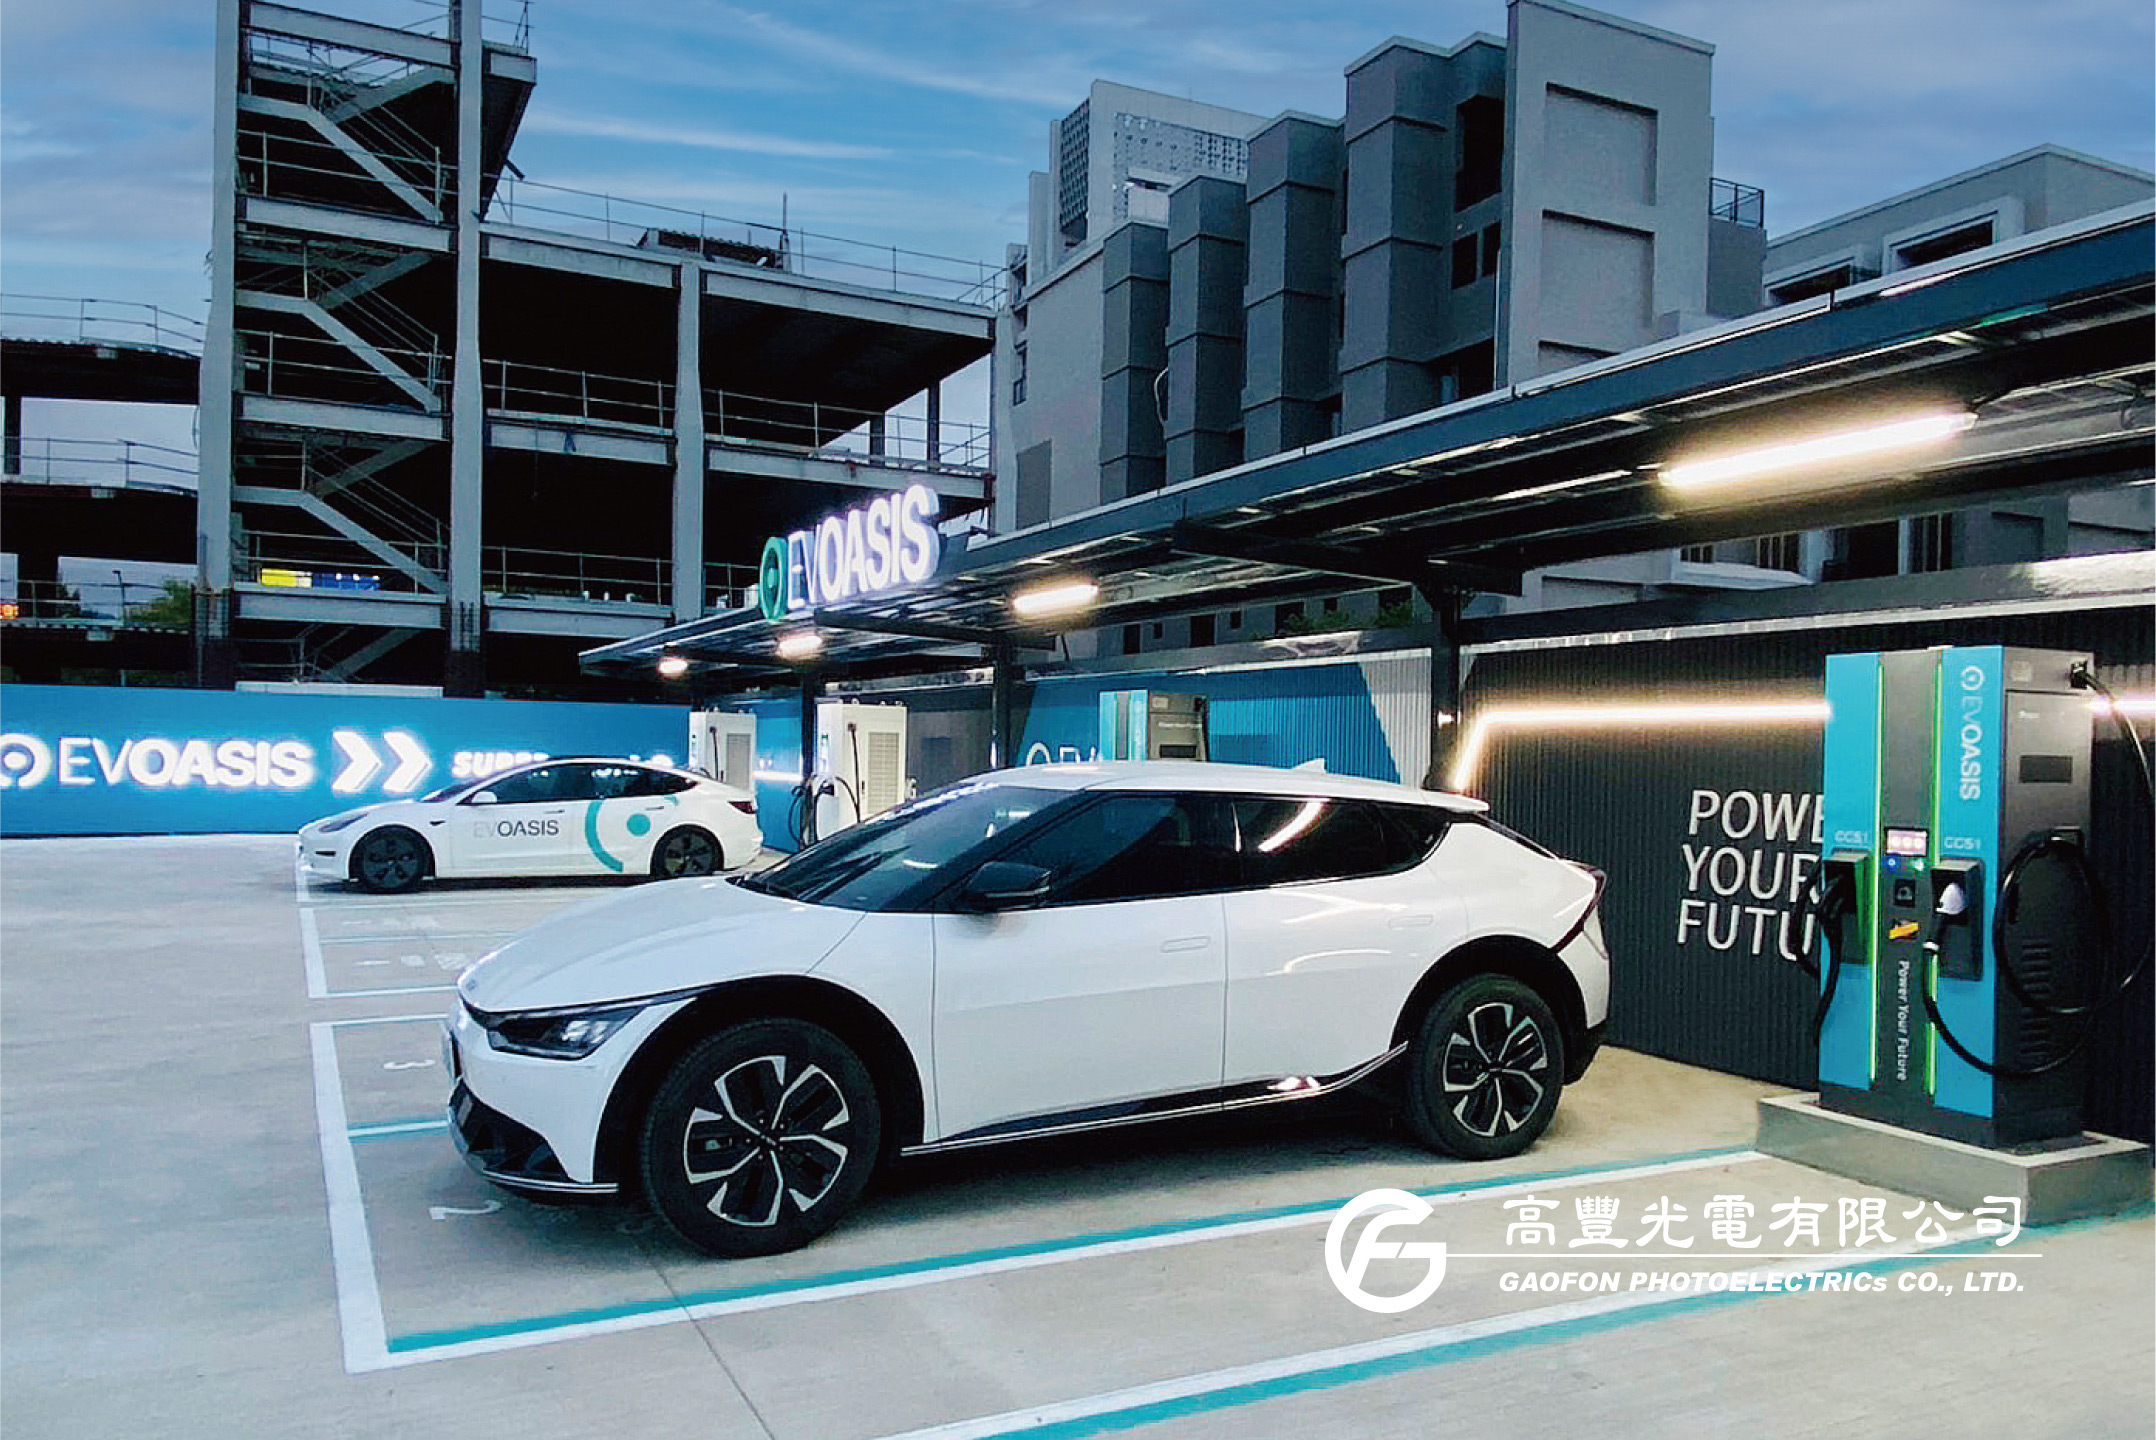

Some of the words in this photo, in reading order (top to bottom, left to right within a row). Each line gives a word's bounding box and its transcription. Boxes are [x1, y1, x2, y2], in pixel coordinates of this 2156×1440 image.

[787, 484, 938, 609] EVOASIS
[58, 737, 315, 787] EVOASIS
[1959, 695, 1984, 801] EVOASIS
[472, 819, 560, 838] EVOASIS
[1688, 789, 1825, 843] POWE
[1682, 843, 1821, 905] YOUR
[1676, 898, 1816, 962] FUTU
[1897, 959, 1911, 1002] Power
[1897, 1004, 1910, 1034] Your
[1897, 1037, 1910, 1081] Future
